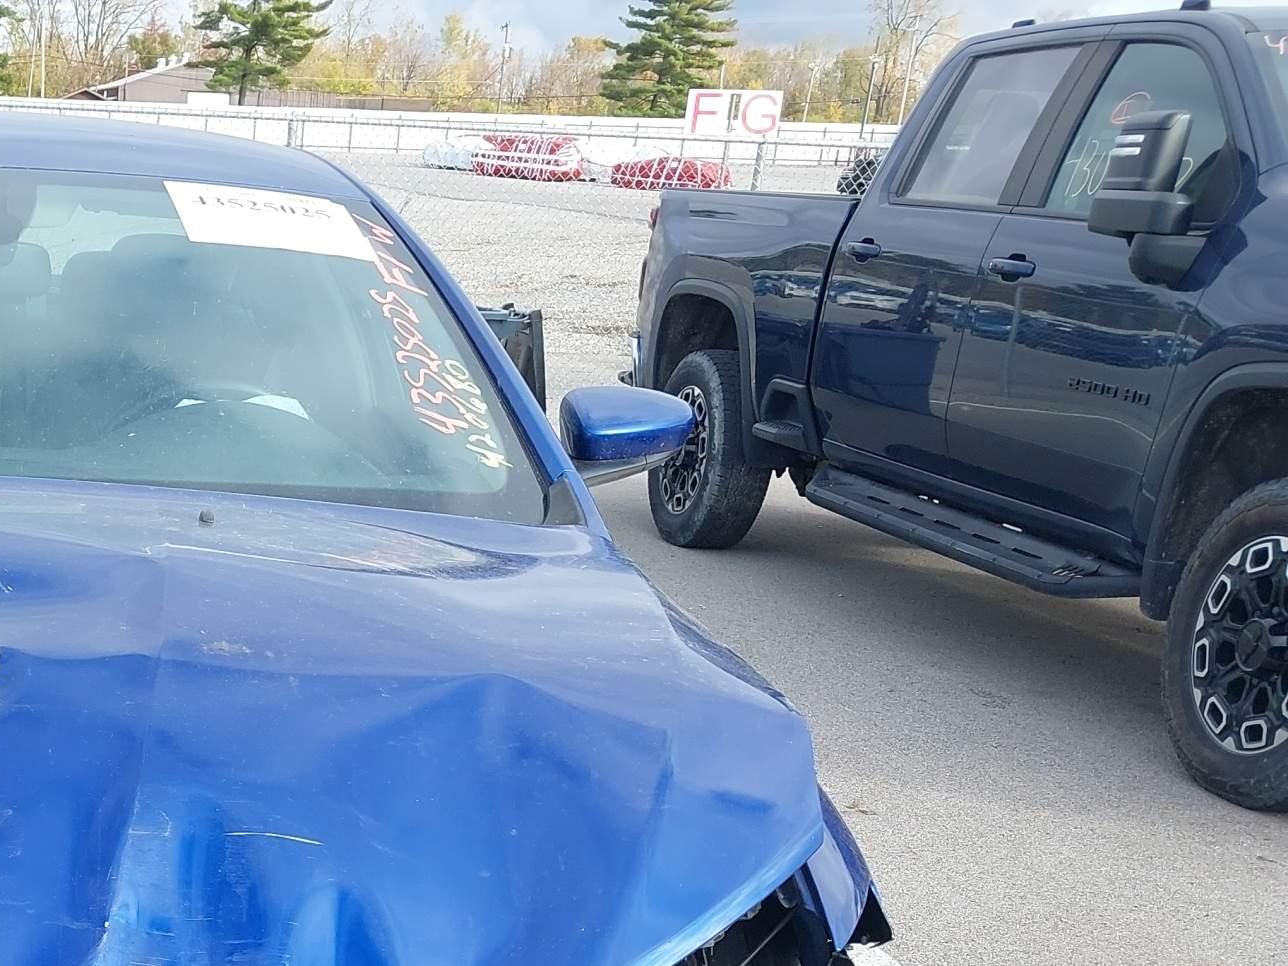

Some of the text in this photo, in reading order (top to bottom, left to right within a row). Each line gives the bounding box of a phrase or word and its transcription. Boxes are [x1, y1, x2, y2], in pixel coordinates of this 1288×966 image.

[369, 289, 469, 434] 43525025
[1067, 376, 1152, 407] 2500 HD
